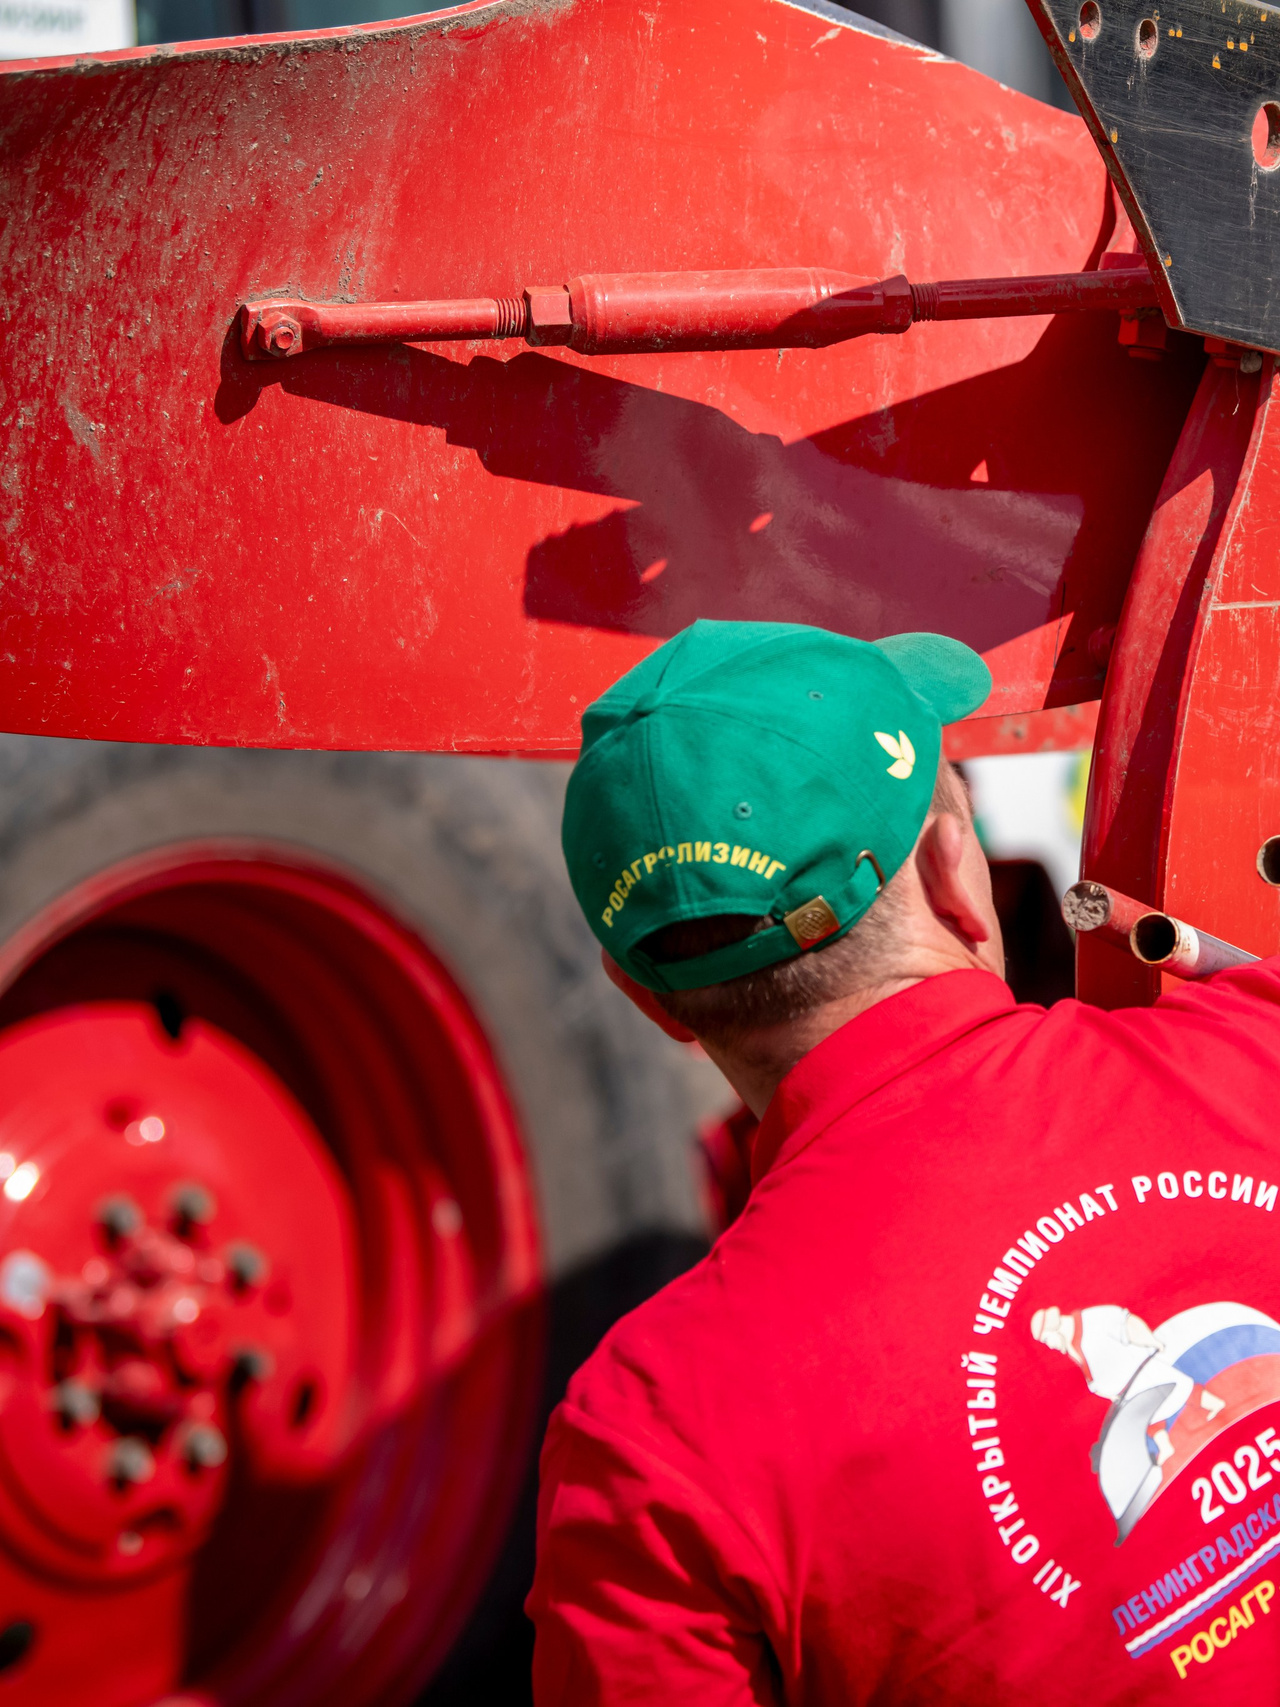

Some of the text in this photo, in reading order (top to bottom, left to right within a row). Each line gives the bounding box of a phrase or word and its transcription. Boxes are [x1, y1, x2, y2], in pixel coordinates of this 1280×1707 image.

[973, 1183, 1118, 1335] ЧЕМПИОНАТ
[1131, 1170, 1279, 1212] РОССИИ
[961, 1351, 1040, 1564] ОТКРЫТЫЙ
